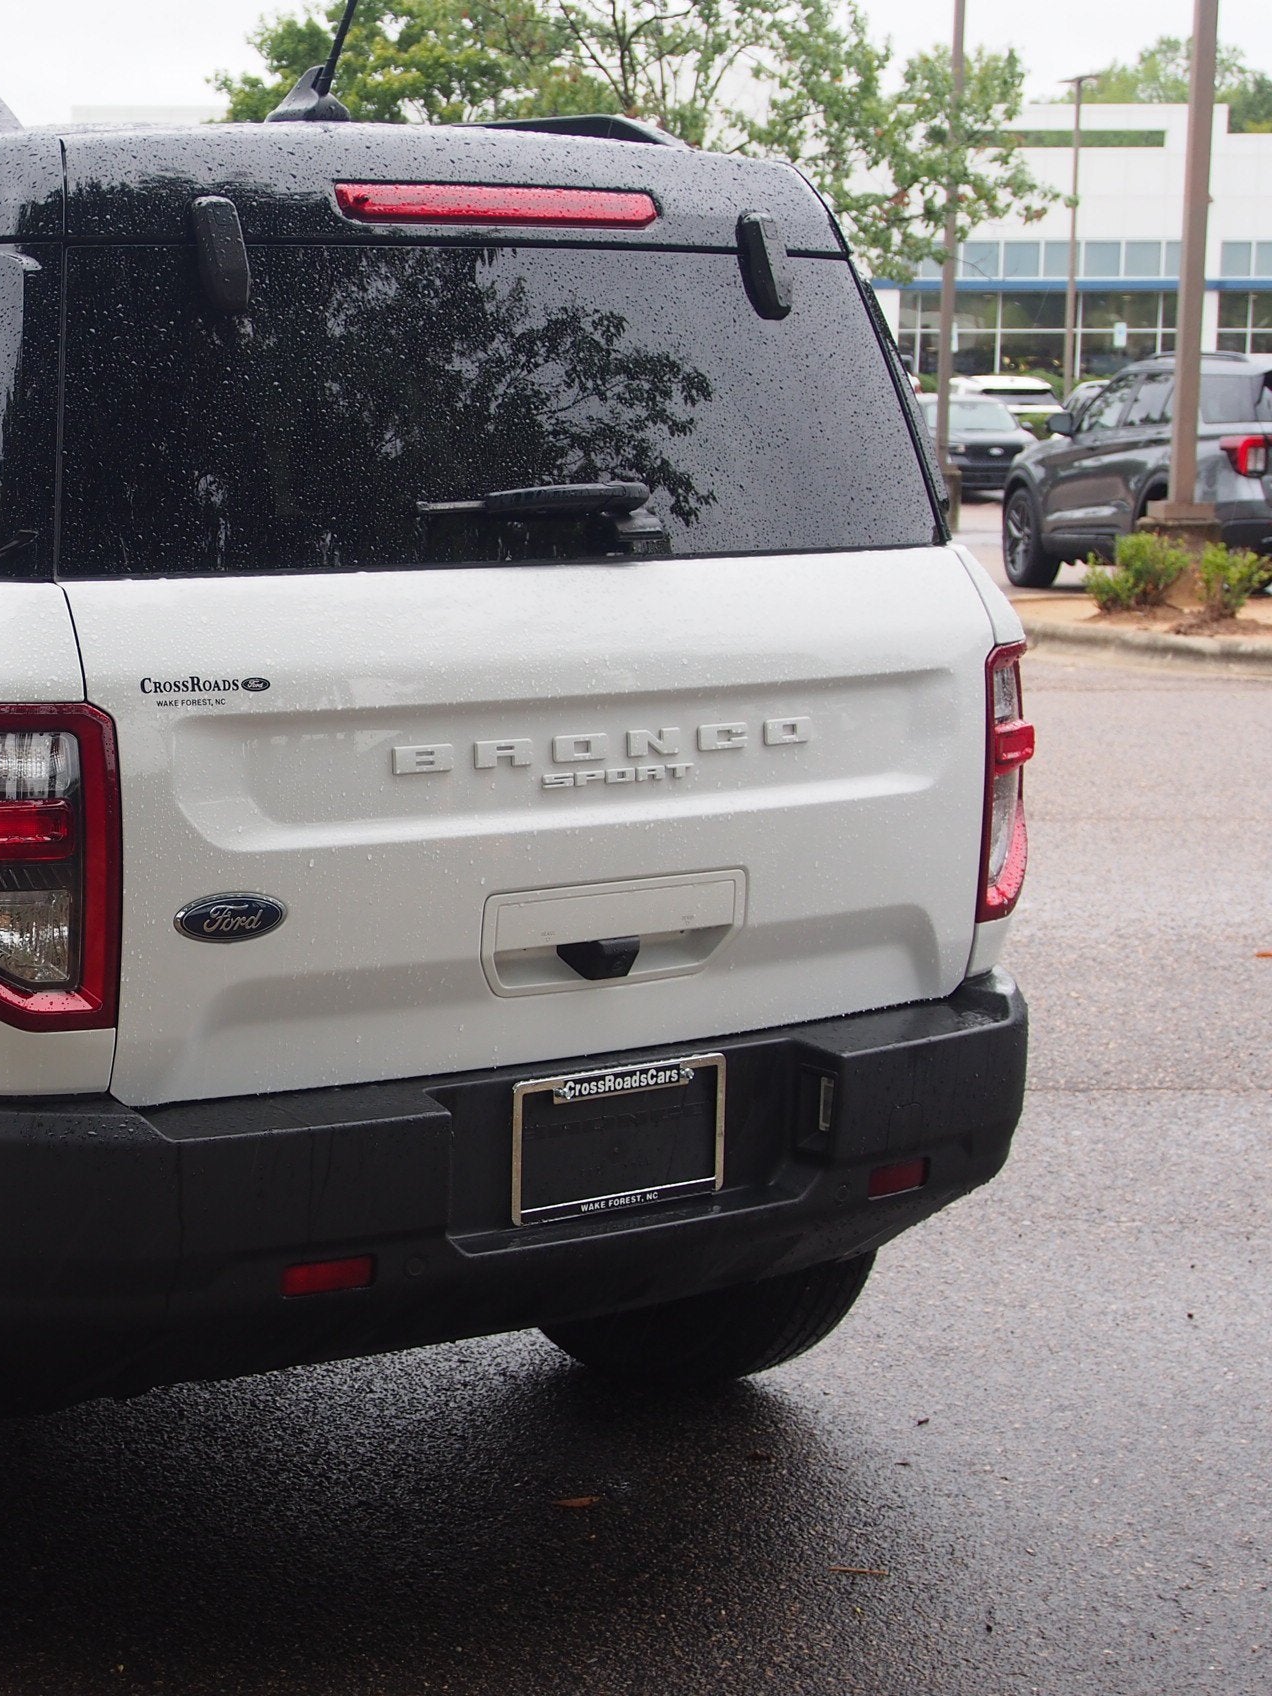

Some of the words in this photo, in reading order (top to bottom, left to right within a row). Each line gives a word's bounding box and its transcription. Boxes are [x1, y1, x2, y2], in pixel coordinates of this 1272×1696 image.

[156, 699, 179, 707] WAKE
[181, 698, 214, 707] FOREST,
[215, 698, 226, 706] NC
[392, 716, 812, 775] BRONCO
[542, 762, 694, 789] SPORT
[203, 904, 264, 933] Ford
[566, 1068, 679, 1098] CrossRoadsCars
[580, 1201, 606, 1212] WAKE
[608, 1194, 644, 1207] FOREST,
[646, 1192, 659, 1200] NC
